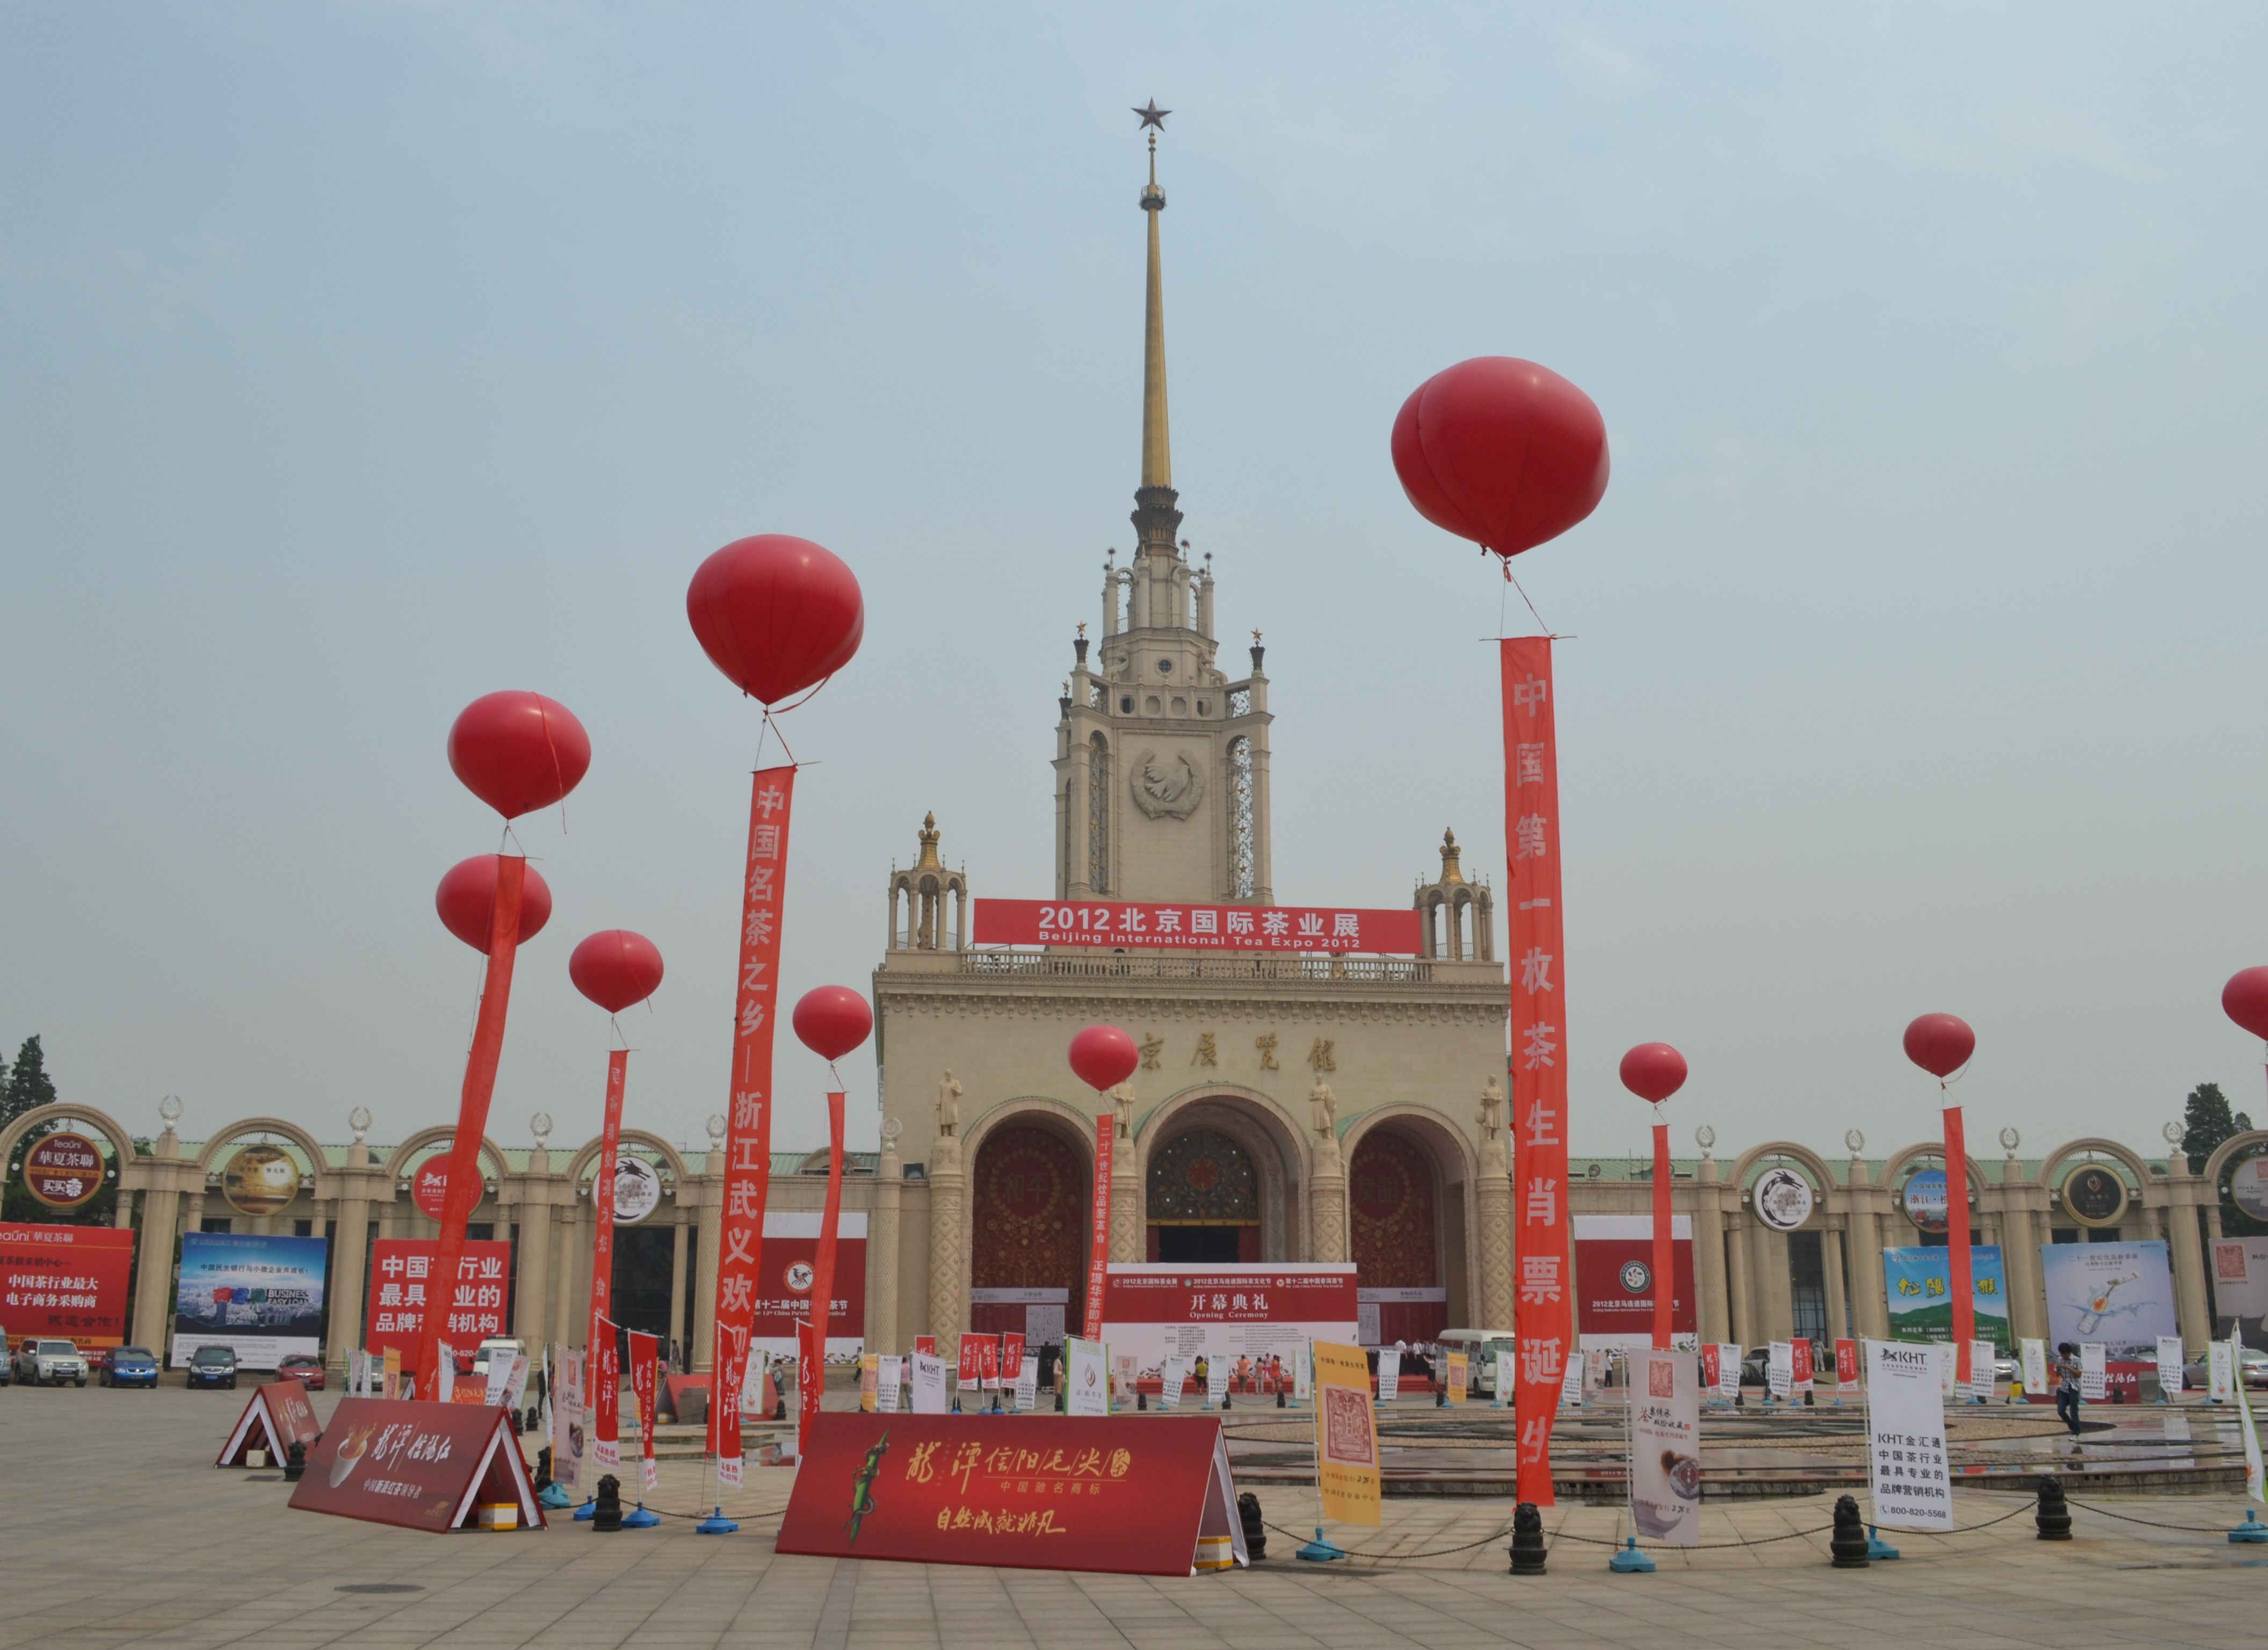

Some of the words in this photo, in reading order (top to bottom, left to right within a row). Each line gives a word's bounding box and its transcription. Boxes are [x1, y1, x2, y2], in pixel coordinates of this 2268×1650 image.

[1039, 907, 1360, 938] 2012北京国际茶业展
[1039, 931, 1102, 944] Beijing
[1111, 933, 1224, 945] International
[1234, 937, 1263, 946] Tea
[1272, 938, 1313, 949] Expo
[1322, 939, 1360, 949] 2012
[1513, 673, 1562, 1465] 中国第一枚茶生肖票诞生
[381, 1255, 502, 1279] 中国行业
[9, 1274, 98, 1290] 中国茶行业最大
[6, 1292, 97, 1308] 电子商务采购商
[379, 1283, 501, 1308] 最具业的
[1190, 1293, 1269, 1311] 开幕典礼
[1190, 1311, 1224, 1320] Opening
[1228, 1311, 1269, 1320] Ceremony
[1899, 1351, 1927, 1365] KHT
[927, 1364, 940, 1376] KHT
[1879, 1450, 1943, 1465] 中国茶行业
[1880, 1465, 1943, 1480] 最具专业的
[1000, 1480, 1101, 1495] 中国驰名商标
[1880, 1483, 1945, 1499] 品牌营销机构
[1890, 1507, 1946, 1518] 800-820-5568
